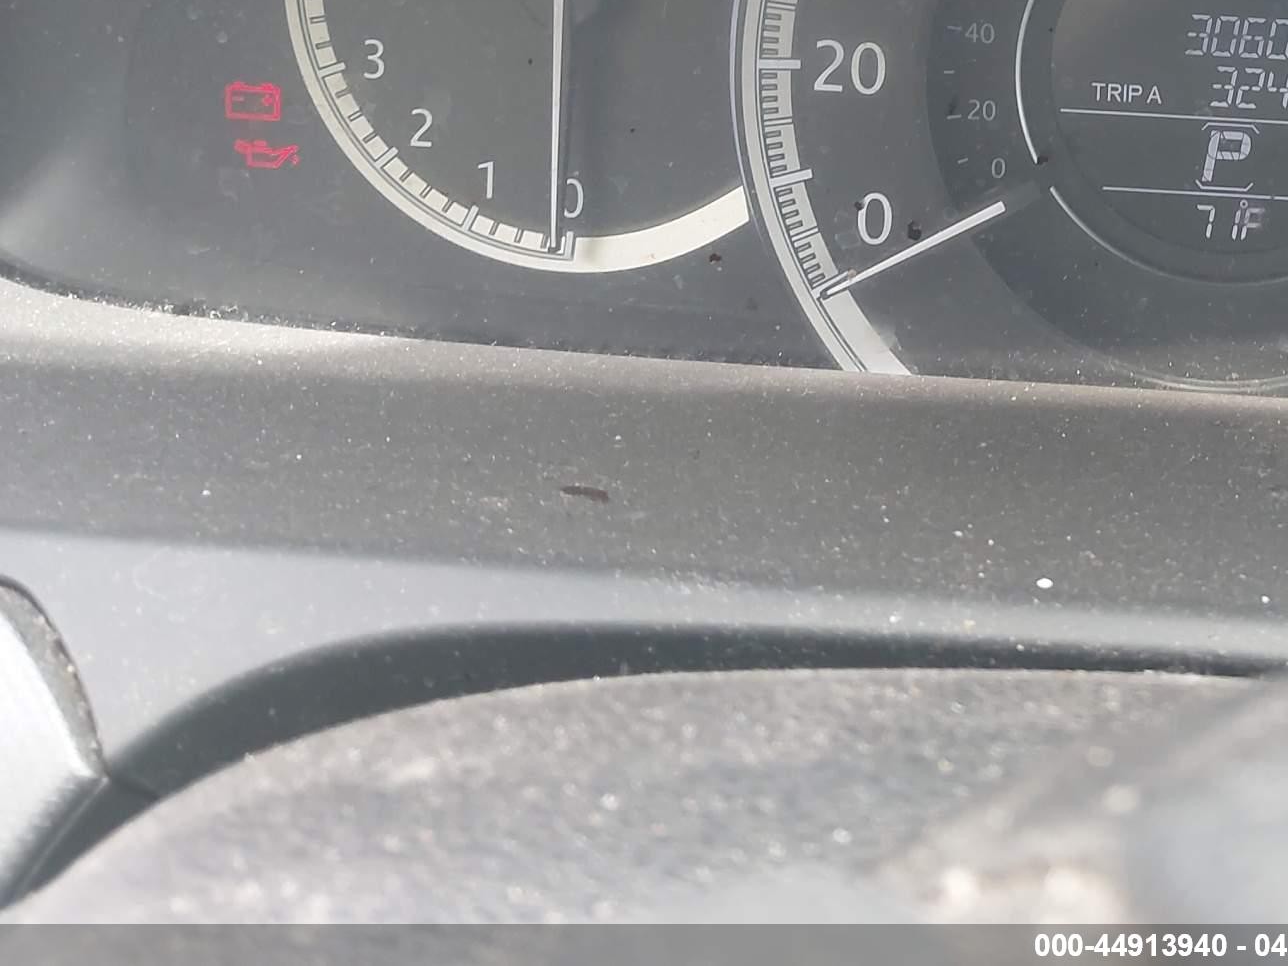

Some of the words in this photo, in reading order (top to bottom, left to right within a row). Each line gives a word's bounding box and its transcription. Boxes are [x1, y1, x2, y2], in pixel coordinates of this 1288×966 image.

[964, 22, 995, 44] 40
[363, 38, 386, 80] 3
[813, 39, 886, 95] 20
[967, 99, 996, 121] 20
[1091, 81, 1143, 103] TRIP
[1146, 85, 1162, 105] A
[410, 108, 433, 148] 2
[991, 157, 1006, 179] 0
[1201, 129, 1252, 183] P
[477, 161, 496, 199] 1
[857, 192, 893, 245] 0
